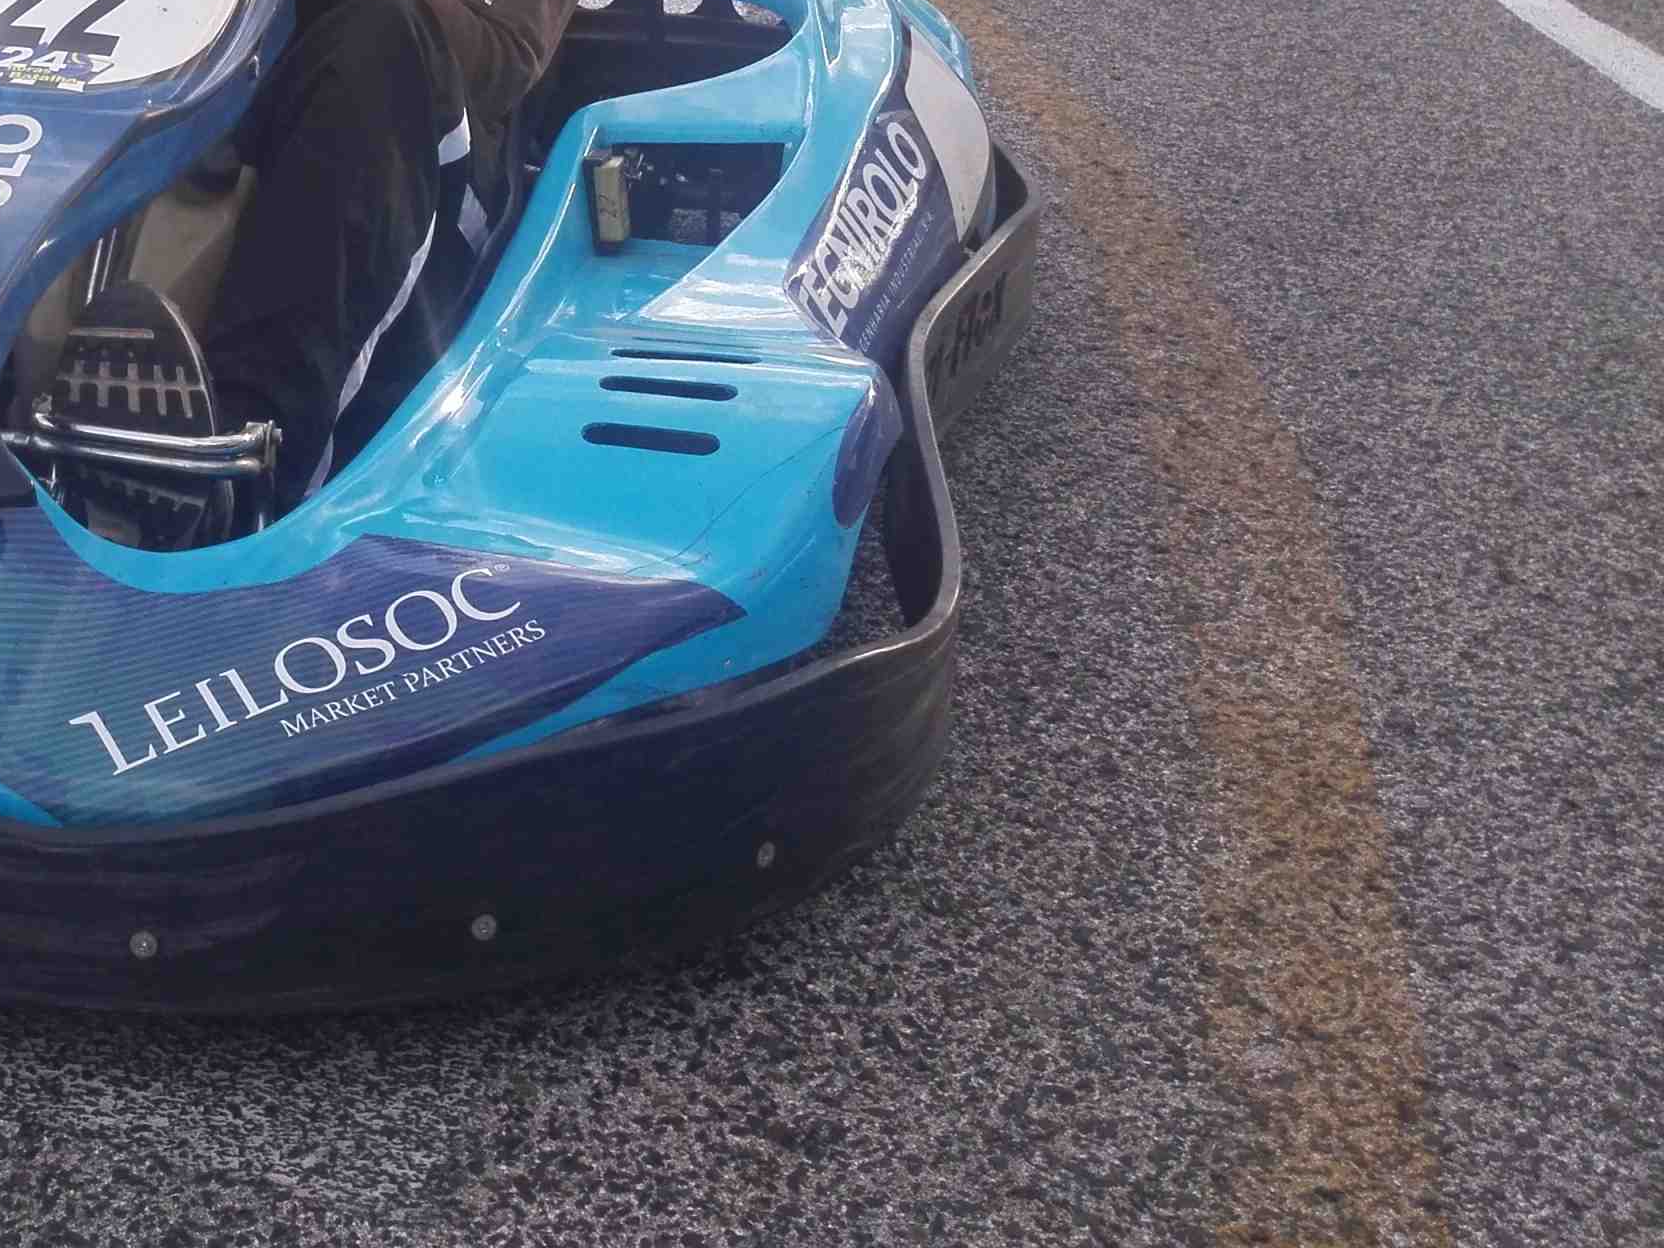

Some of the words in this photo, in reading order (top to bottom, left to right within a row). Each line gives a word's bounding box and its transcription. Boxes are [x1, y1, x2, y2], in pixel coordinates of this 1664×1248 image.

[797, 121, 927, 336] TECNIROLO
[69, 567, 523, 777] LEILOSOC
[279, 680, 398, 738] MARKET
[402, 618, 547, 694] PARTNERS
